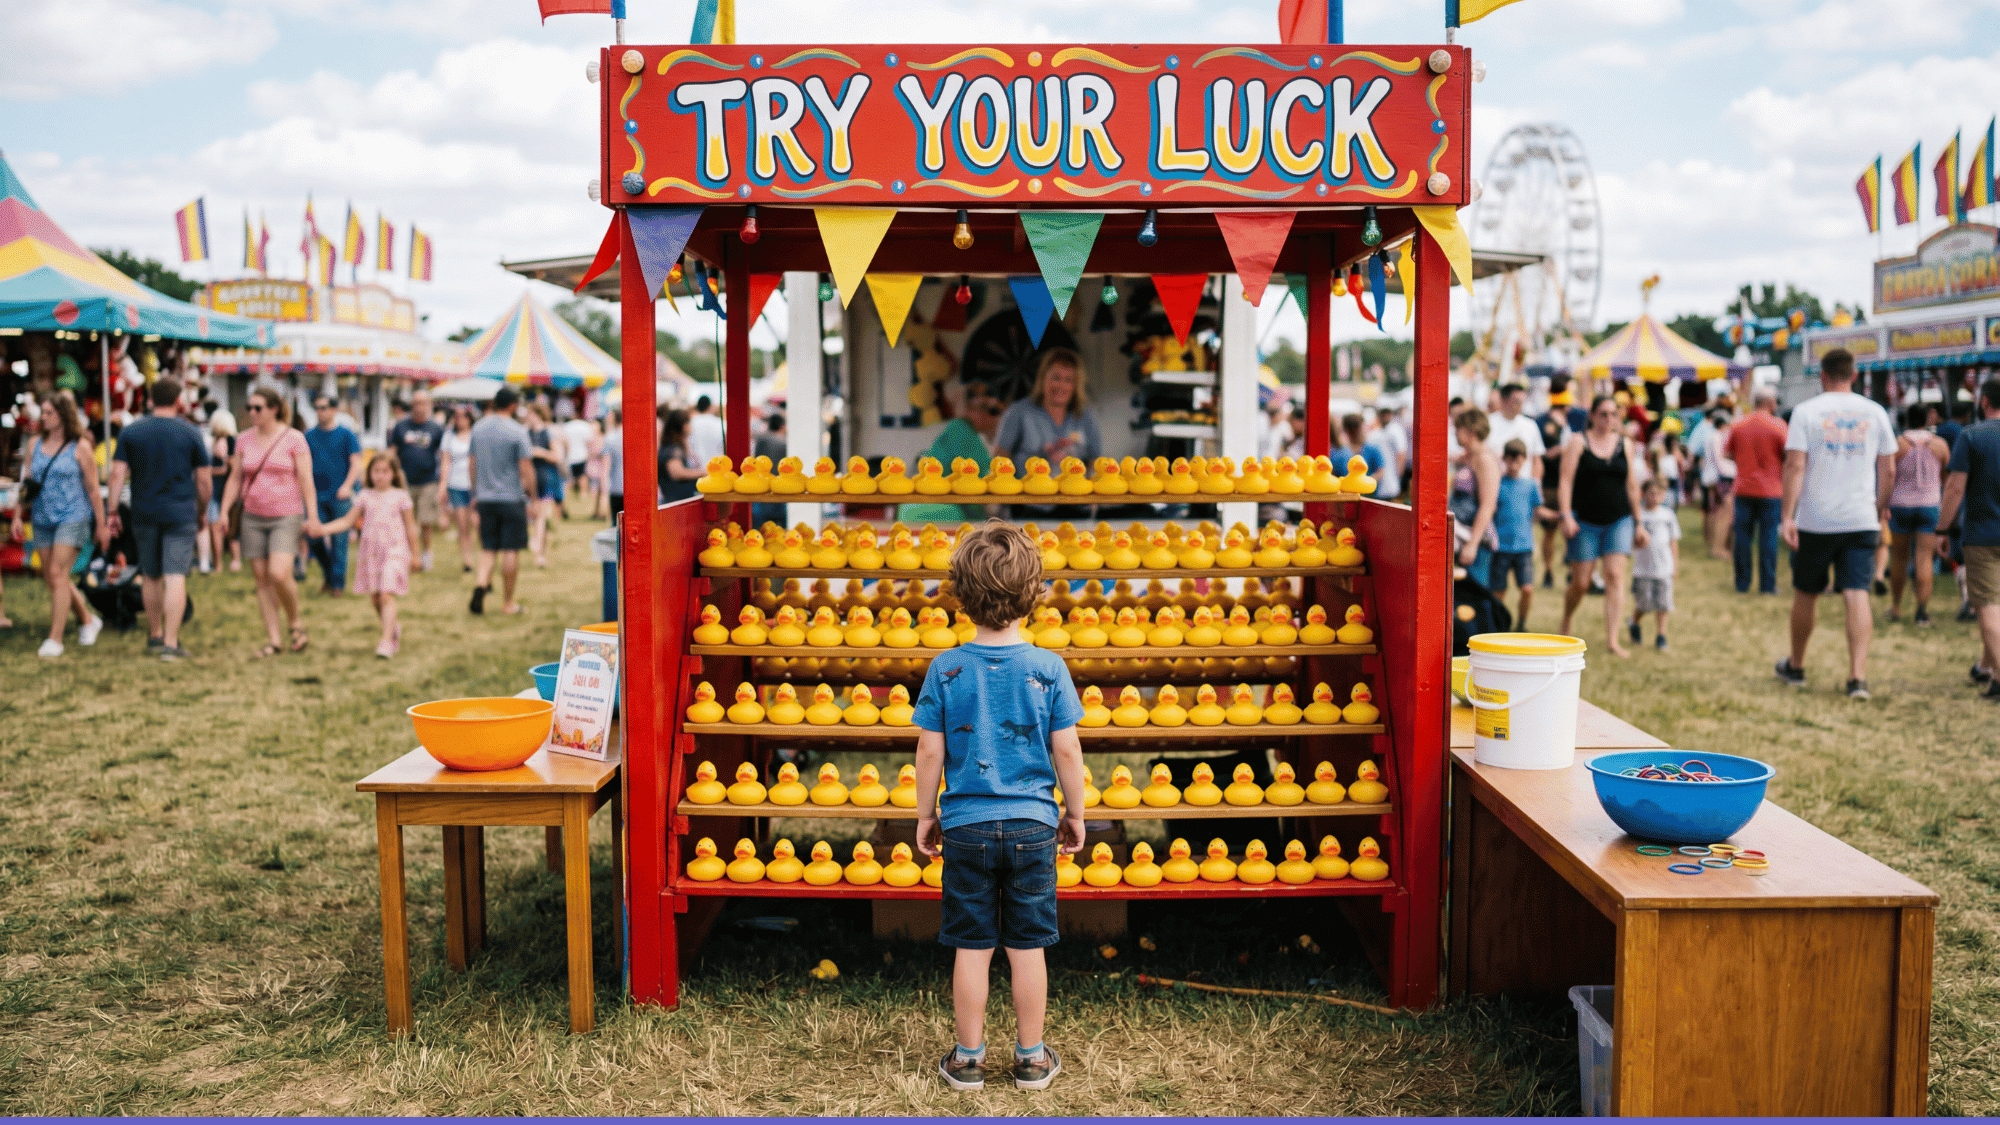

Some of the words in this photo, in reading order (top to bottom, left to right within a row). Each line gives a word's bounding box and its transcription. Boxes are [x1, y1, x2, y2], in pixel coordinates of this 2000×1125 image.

[670, 72, 872, 188] TRY
[894, 71, 1125, 178] YOUR
[1149, 72, 1398, 188] LUCK
